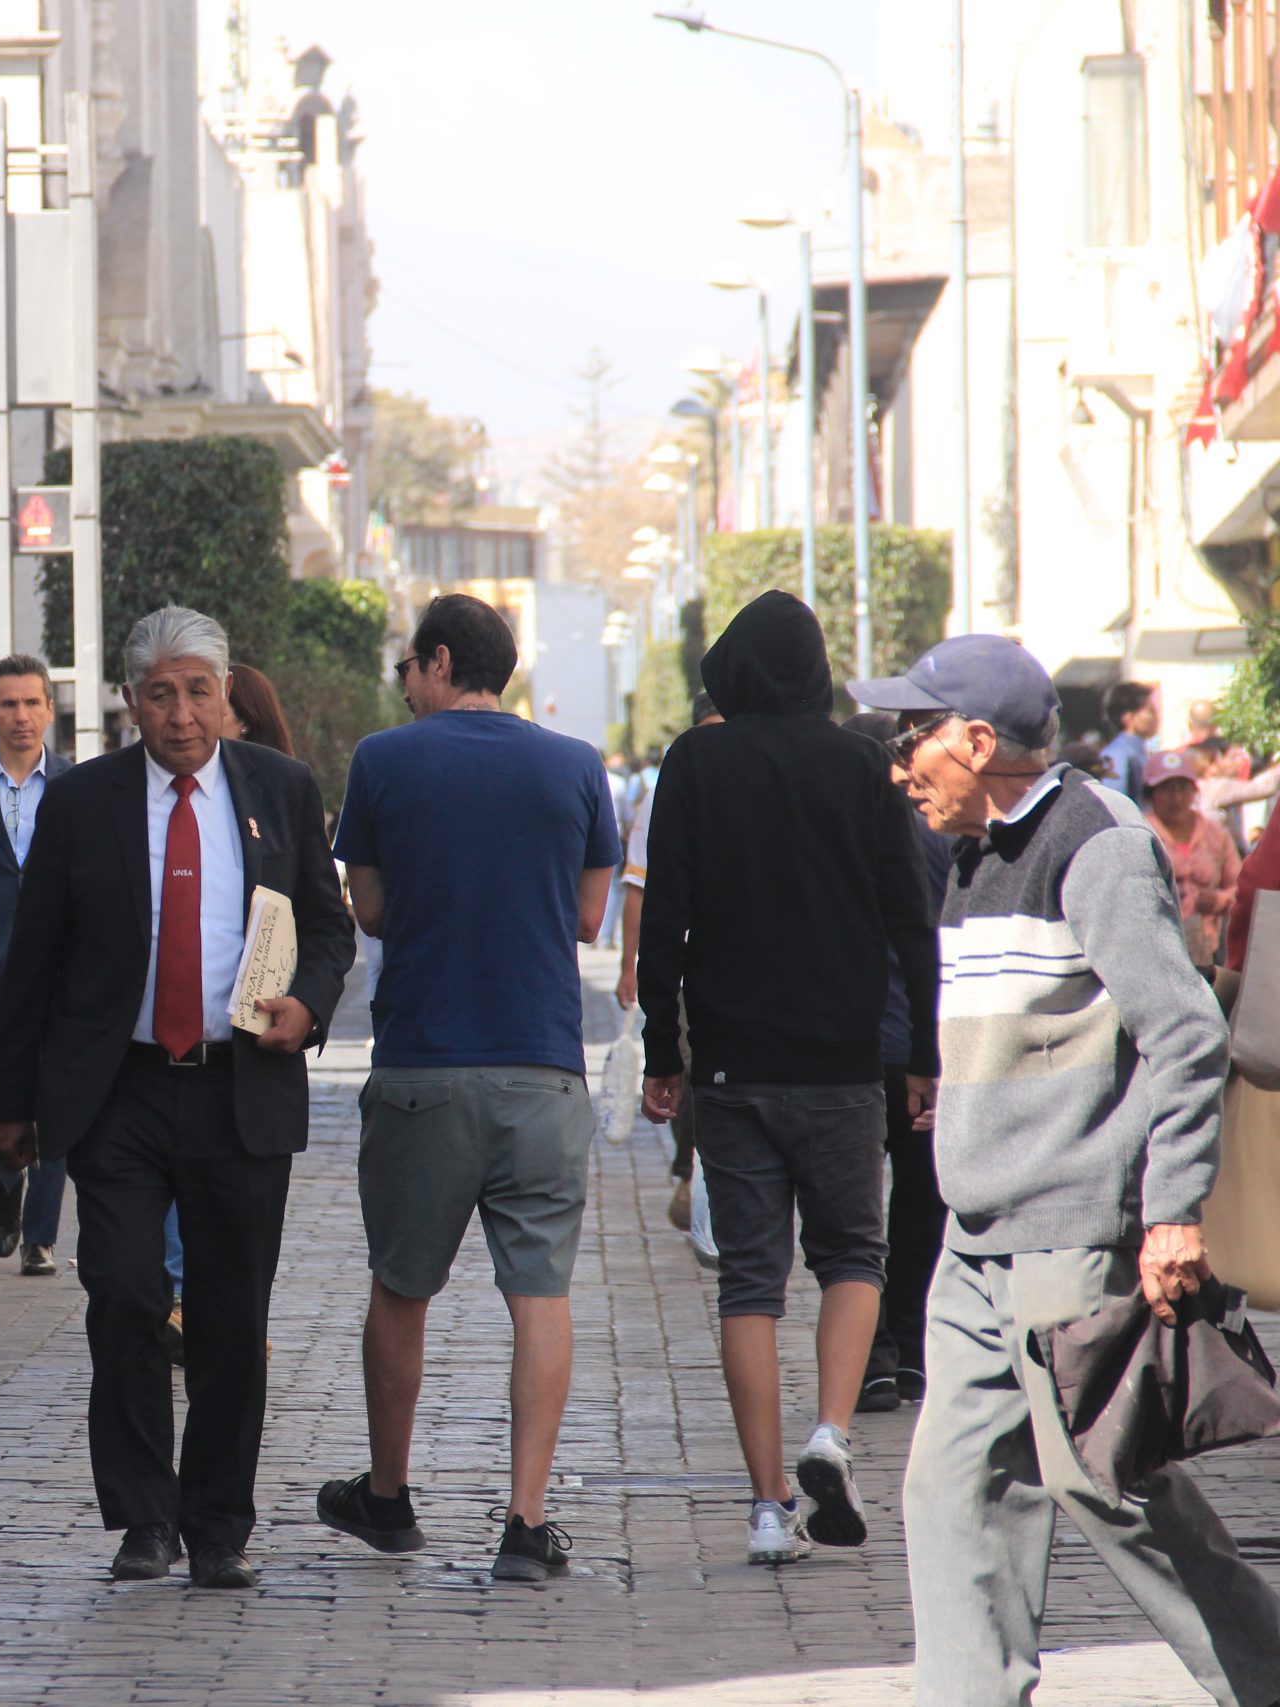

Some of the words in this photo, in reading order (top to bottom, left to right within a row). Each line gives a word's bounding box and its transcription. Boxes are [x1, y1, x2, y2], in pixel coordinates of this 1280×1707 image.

[172, 869, 193, 877] UNSA
[244, 914, 271, 1007] PRACTICAS
[256, 905, 278, 996] PROFESIONALES
